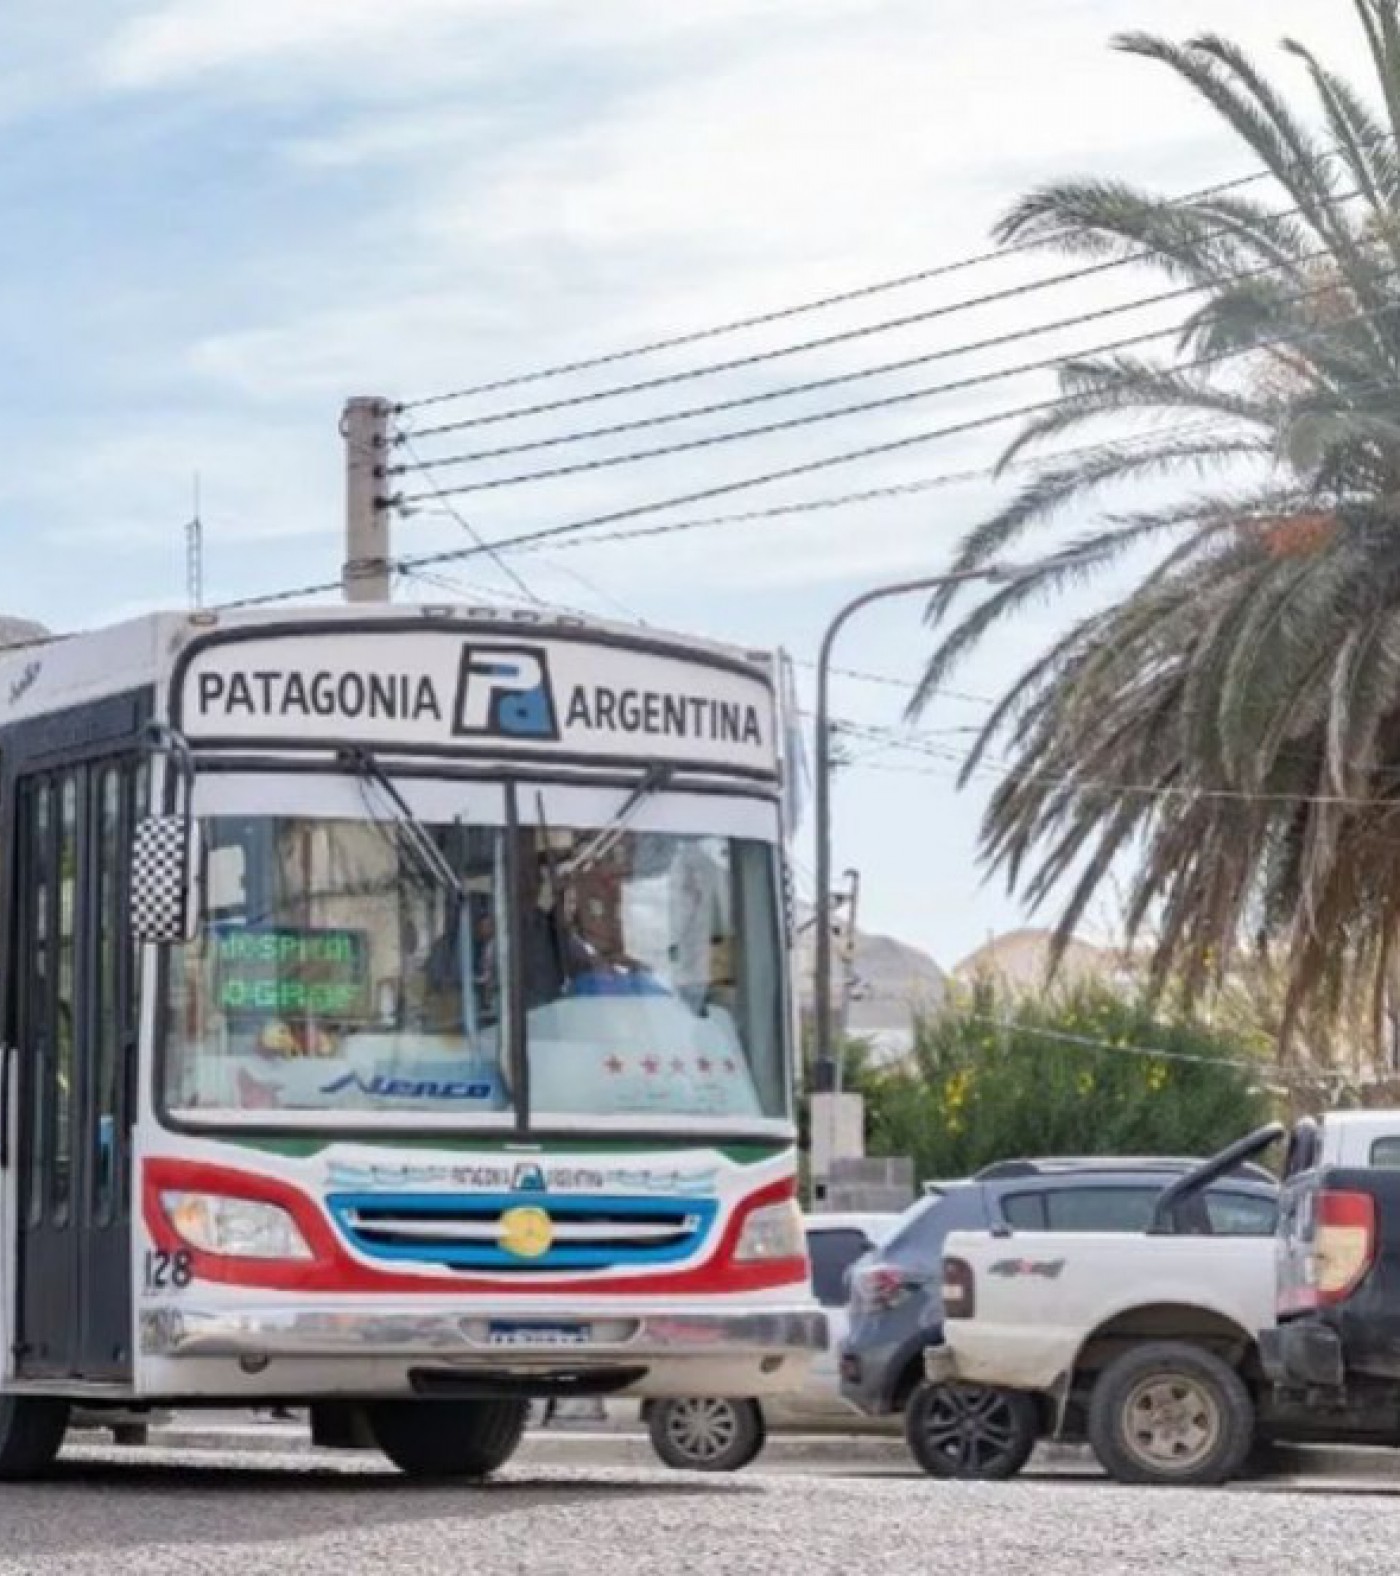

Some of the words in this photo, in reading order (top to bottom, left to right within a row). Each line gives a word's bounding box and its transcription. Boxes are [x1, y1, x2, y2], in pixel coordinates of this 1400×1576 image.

[198, 670, 441, 720] PATAGONIA
[565, 685, 763, 745] ARGENTINA
[144, 1249, 193, 1290] 128
